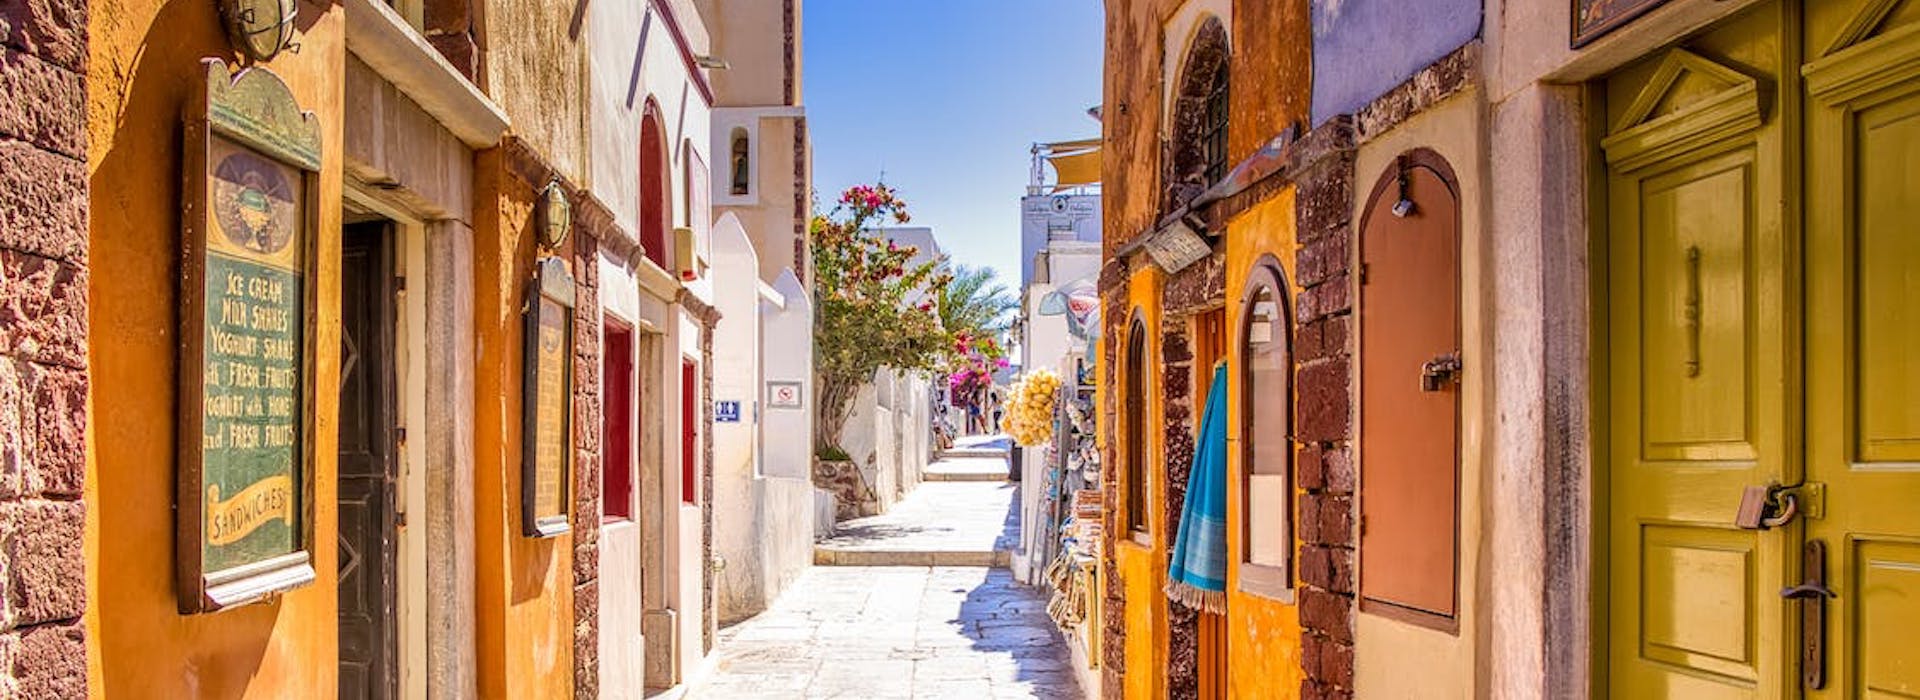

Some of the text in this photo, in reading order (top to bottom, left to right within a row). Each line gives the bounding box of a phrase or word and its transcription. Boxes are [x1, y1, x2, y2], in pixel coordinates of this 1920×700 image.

[226, 272, 282, 304] ICE CREAM
[221, 298, 287, 333] MILK SHAKES
[211, 325, 257, 358] YOGHURT
[204, 361, 296, 390] ith FRESH FRUITS
[230, 422, 259, 450] FRESH
[265, 423, 296, 449] FRUITS
[213, 486, 285, 539] SANDWICHES
